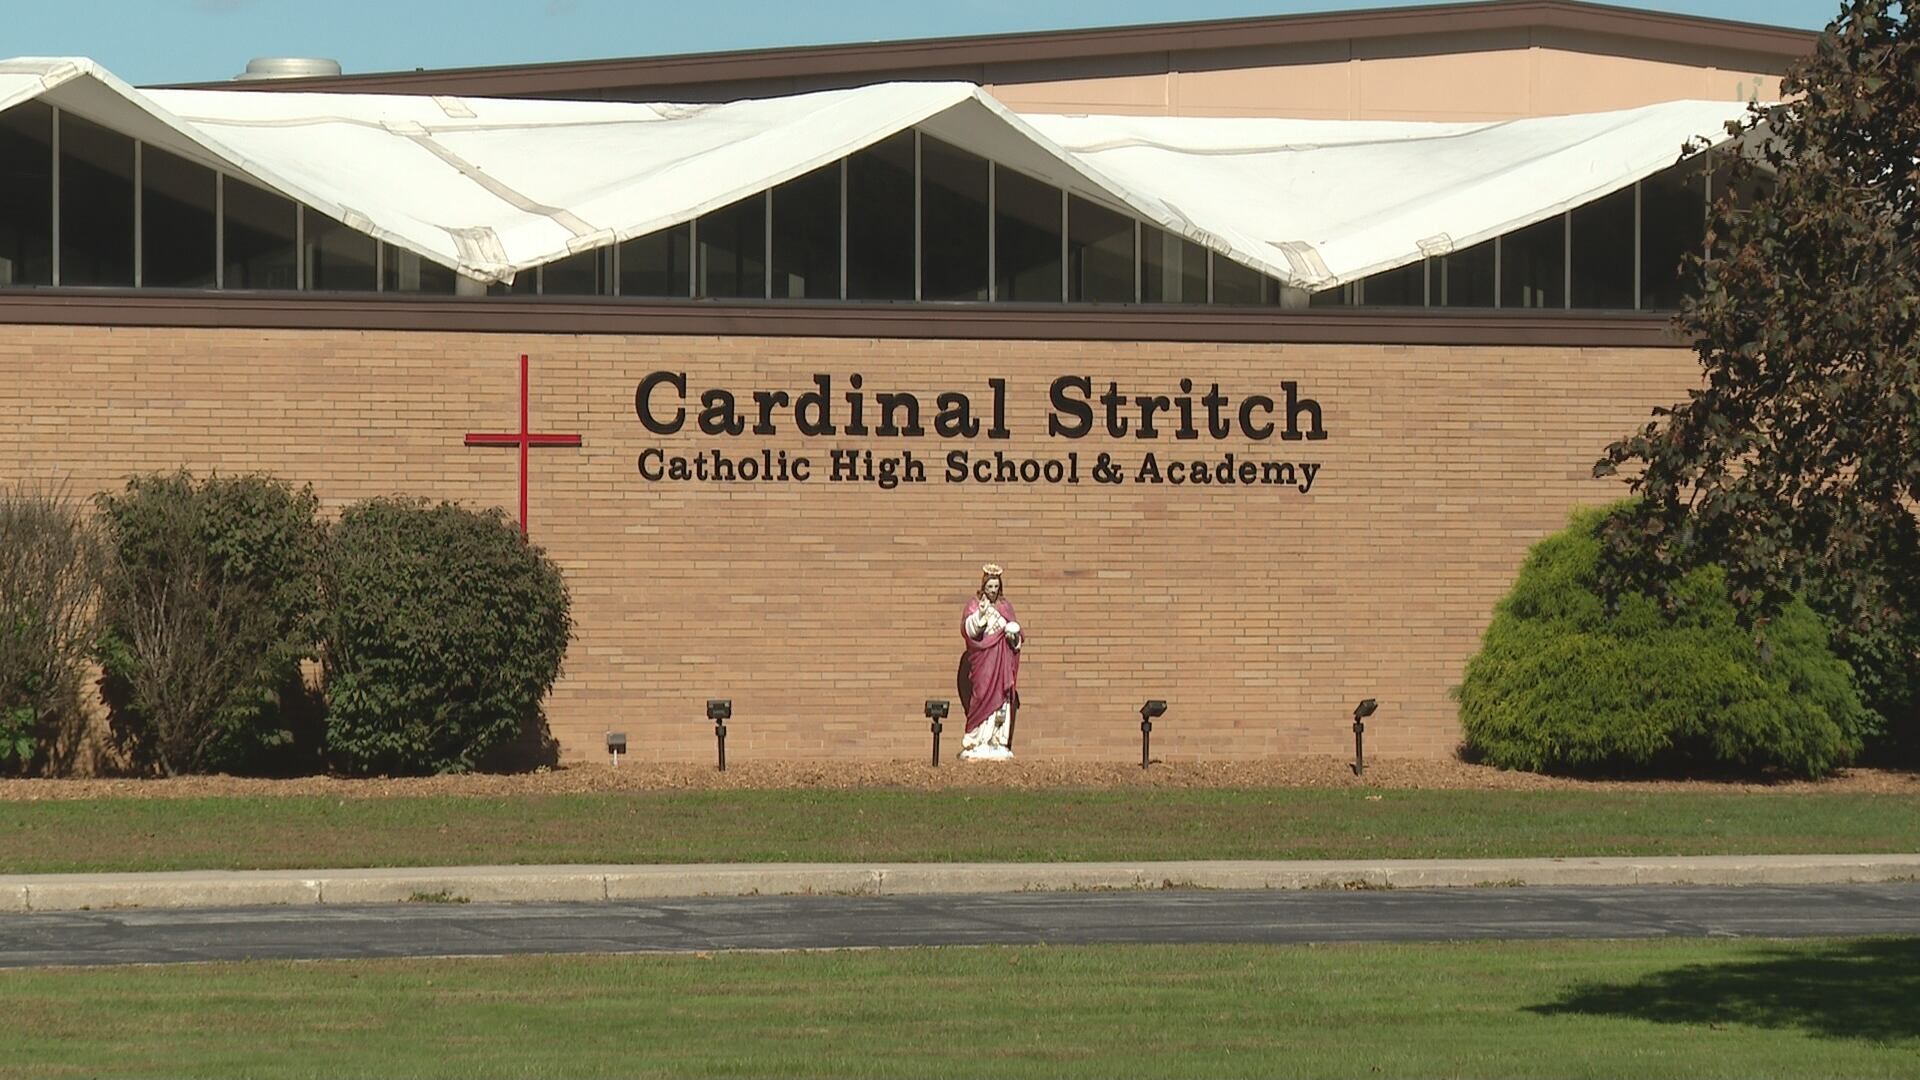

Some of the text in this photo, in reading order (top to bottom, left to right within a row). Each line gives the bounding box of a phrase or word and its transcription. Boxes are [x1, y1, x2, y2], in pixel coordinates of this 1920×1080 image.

[634, 370, 1329, 441] Cardinal Stritch
[637, 447, 1322, 494] Catholic High School & Academy
